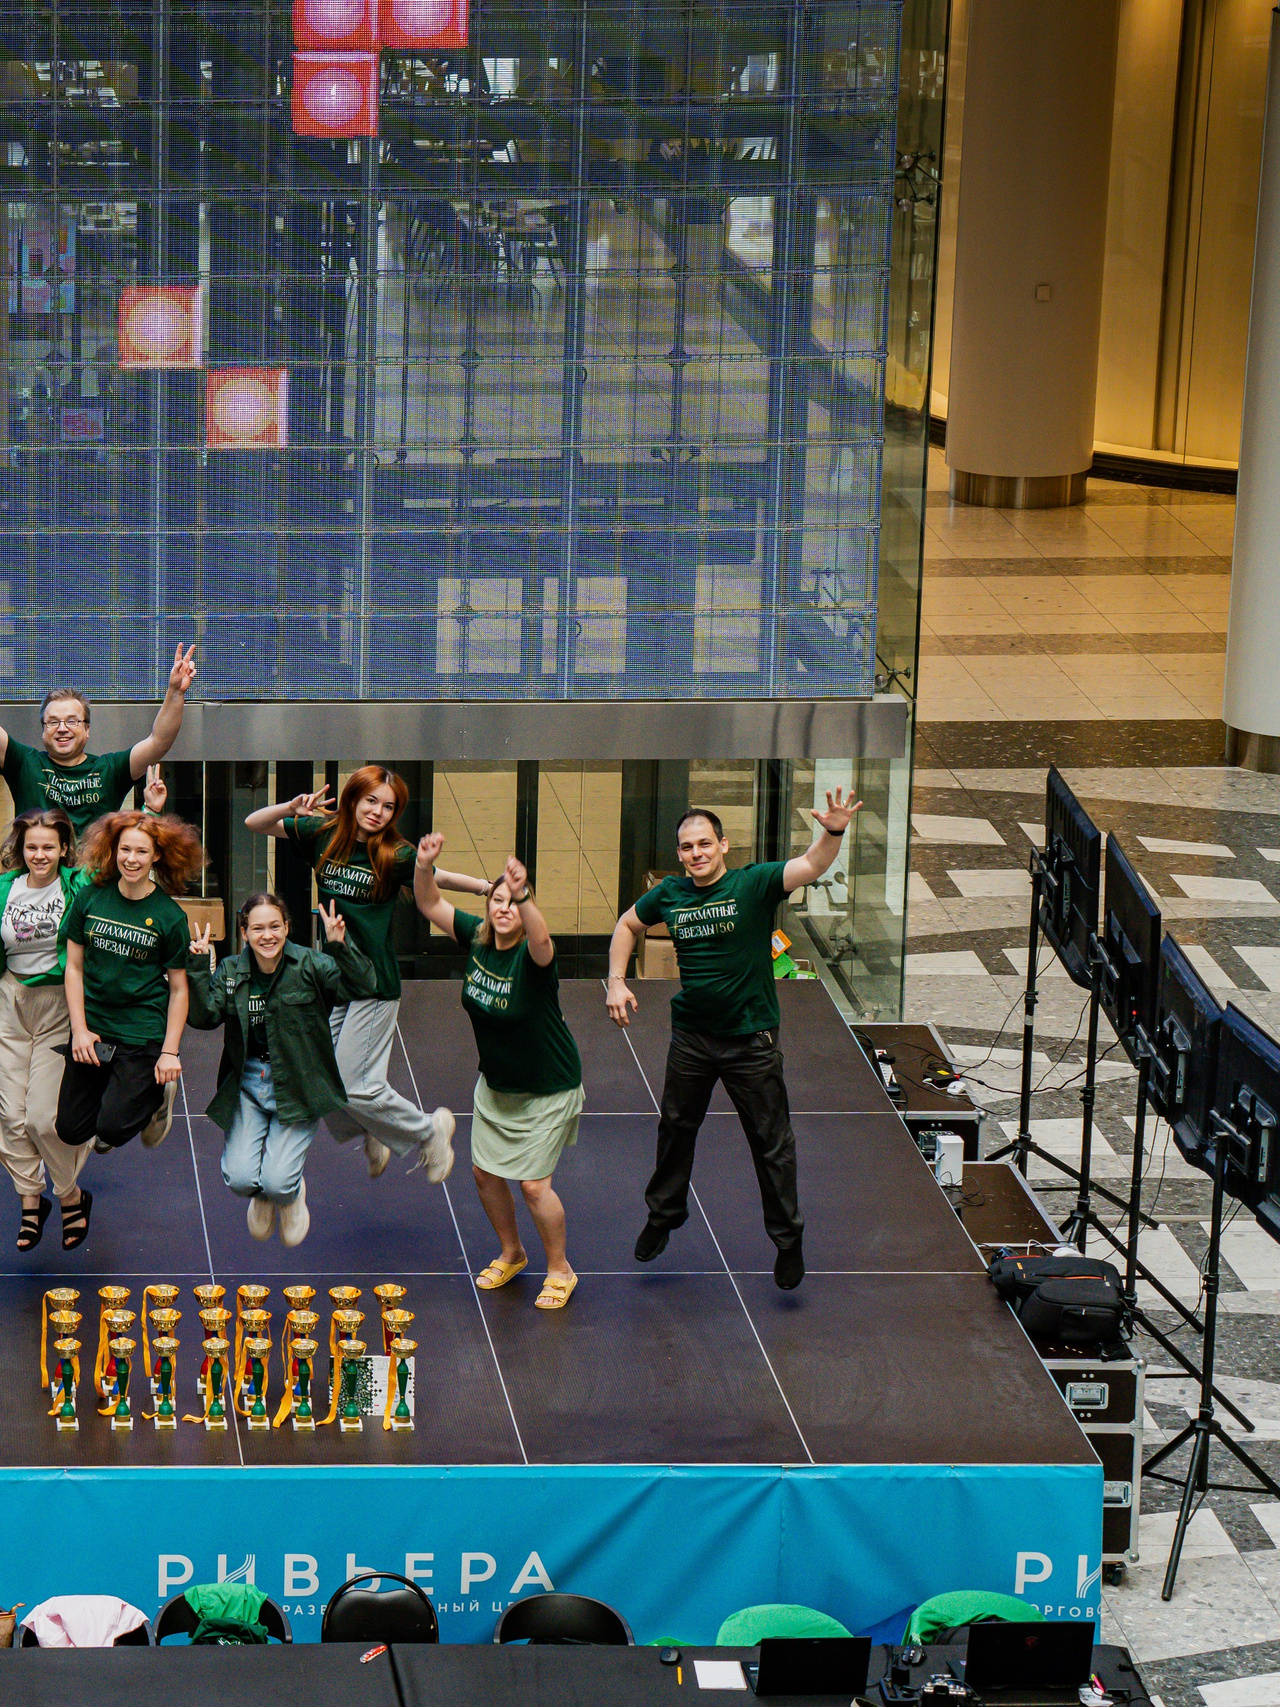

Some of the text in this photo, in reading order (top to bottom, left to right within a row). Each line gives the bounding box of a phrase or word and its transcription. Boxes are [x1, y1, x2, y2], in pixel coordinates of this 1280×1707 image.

[678, 904, 738, 924] ШАХМАТНЫЕ
[95, 922, 158, 947] ШАХМАТНЫЕ
[679, 923, 715, 939] ЗВЕЗДЫ
[93, 937, 130, 956] ЗВЕЗДЫ
[158, 1551, 556, 1598] РИВЬЕРА
